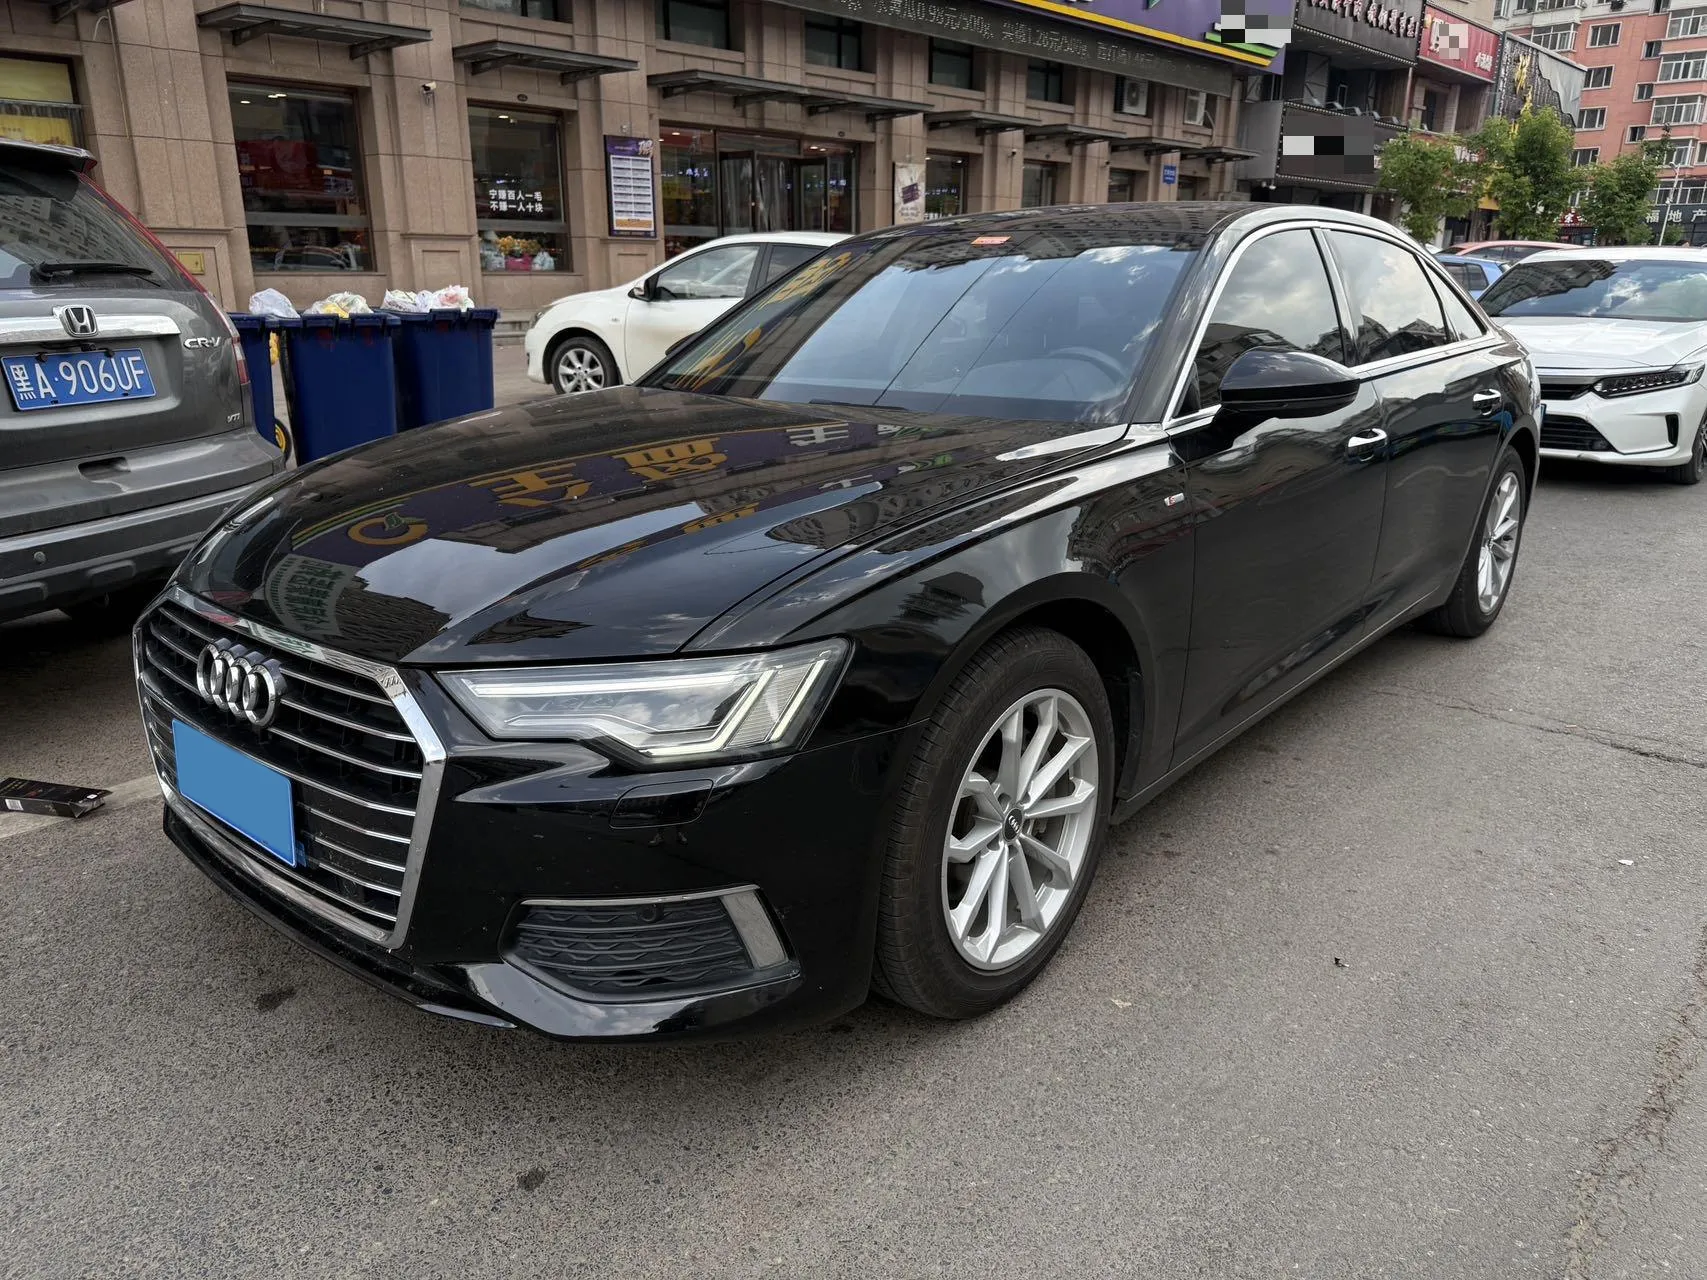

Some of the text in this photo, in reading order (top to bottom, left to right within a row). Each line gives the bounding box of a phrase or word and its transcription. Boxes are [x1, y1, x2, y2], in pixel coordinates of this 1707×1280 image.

[489, 189, 542, 201] 宁赚百人一毛
[490, 201, 543, 212] 不赚一人十块
